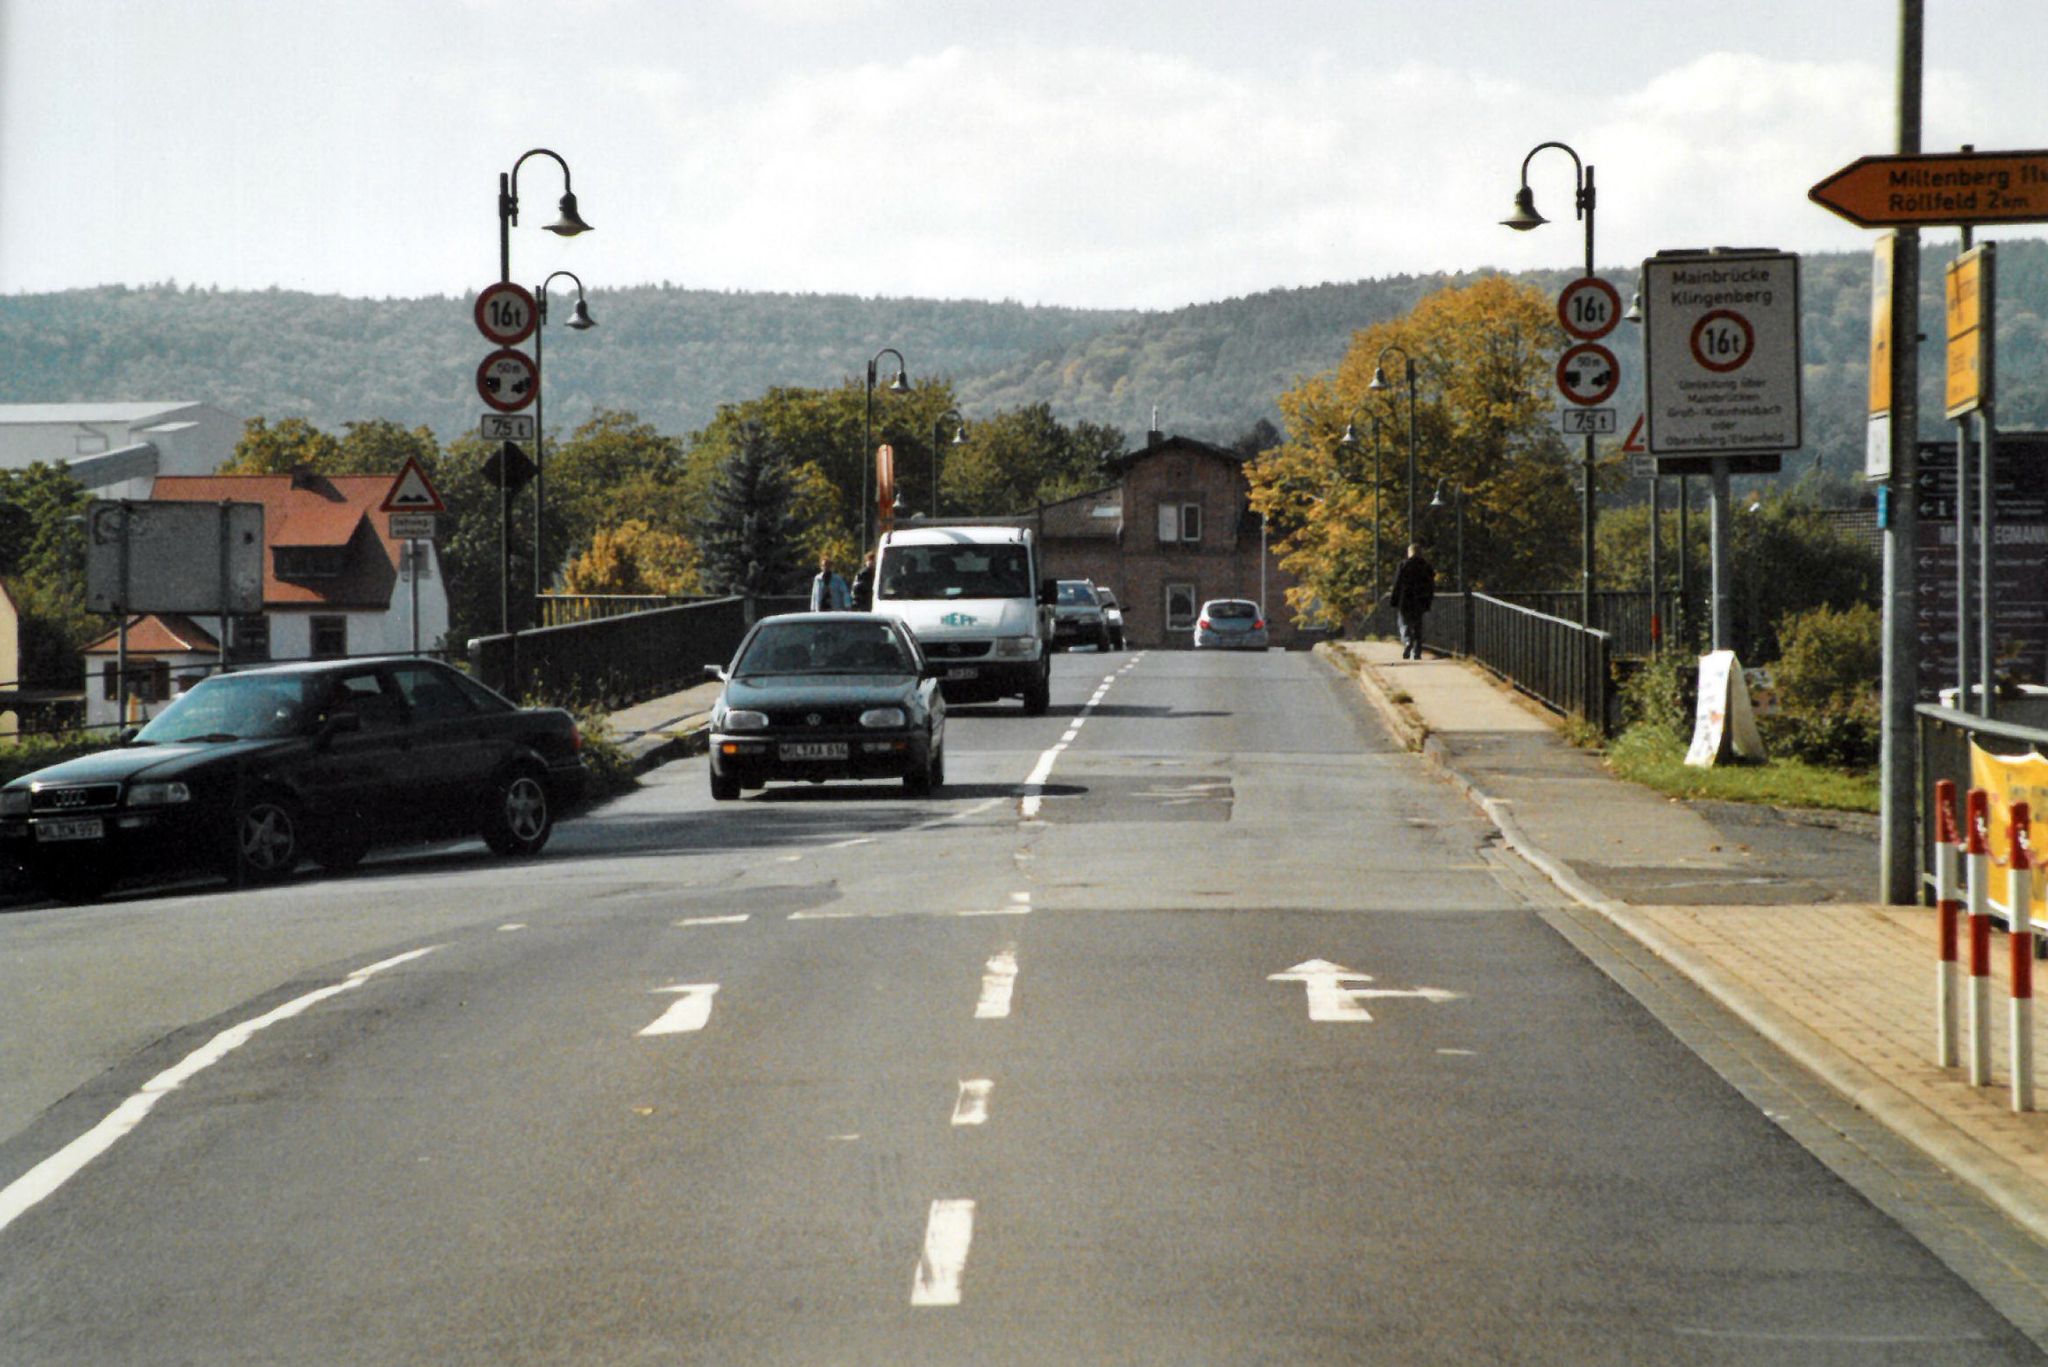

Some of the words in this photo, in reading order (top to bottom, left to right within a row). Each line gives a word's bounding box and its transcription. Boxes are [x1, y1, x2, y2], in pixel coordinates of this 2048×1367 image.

[1888, 167, 2010, 190] Miltenberg
[1888, 190, 1978, 212] Röllfeld
[1671, 267, 1771, 285] Mainbrücke
[1670, 288, 1773, 308] Klingenberg
